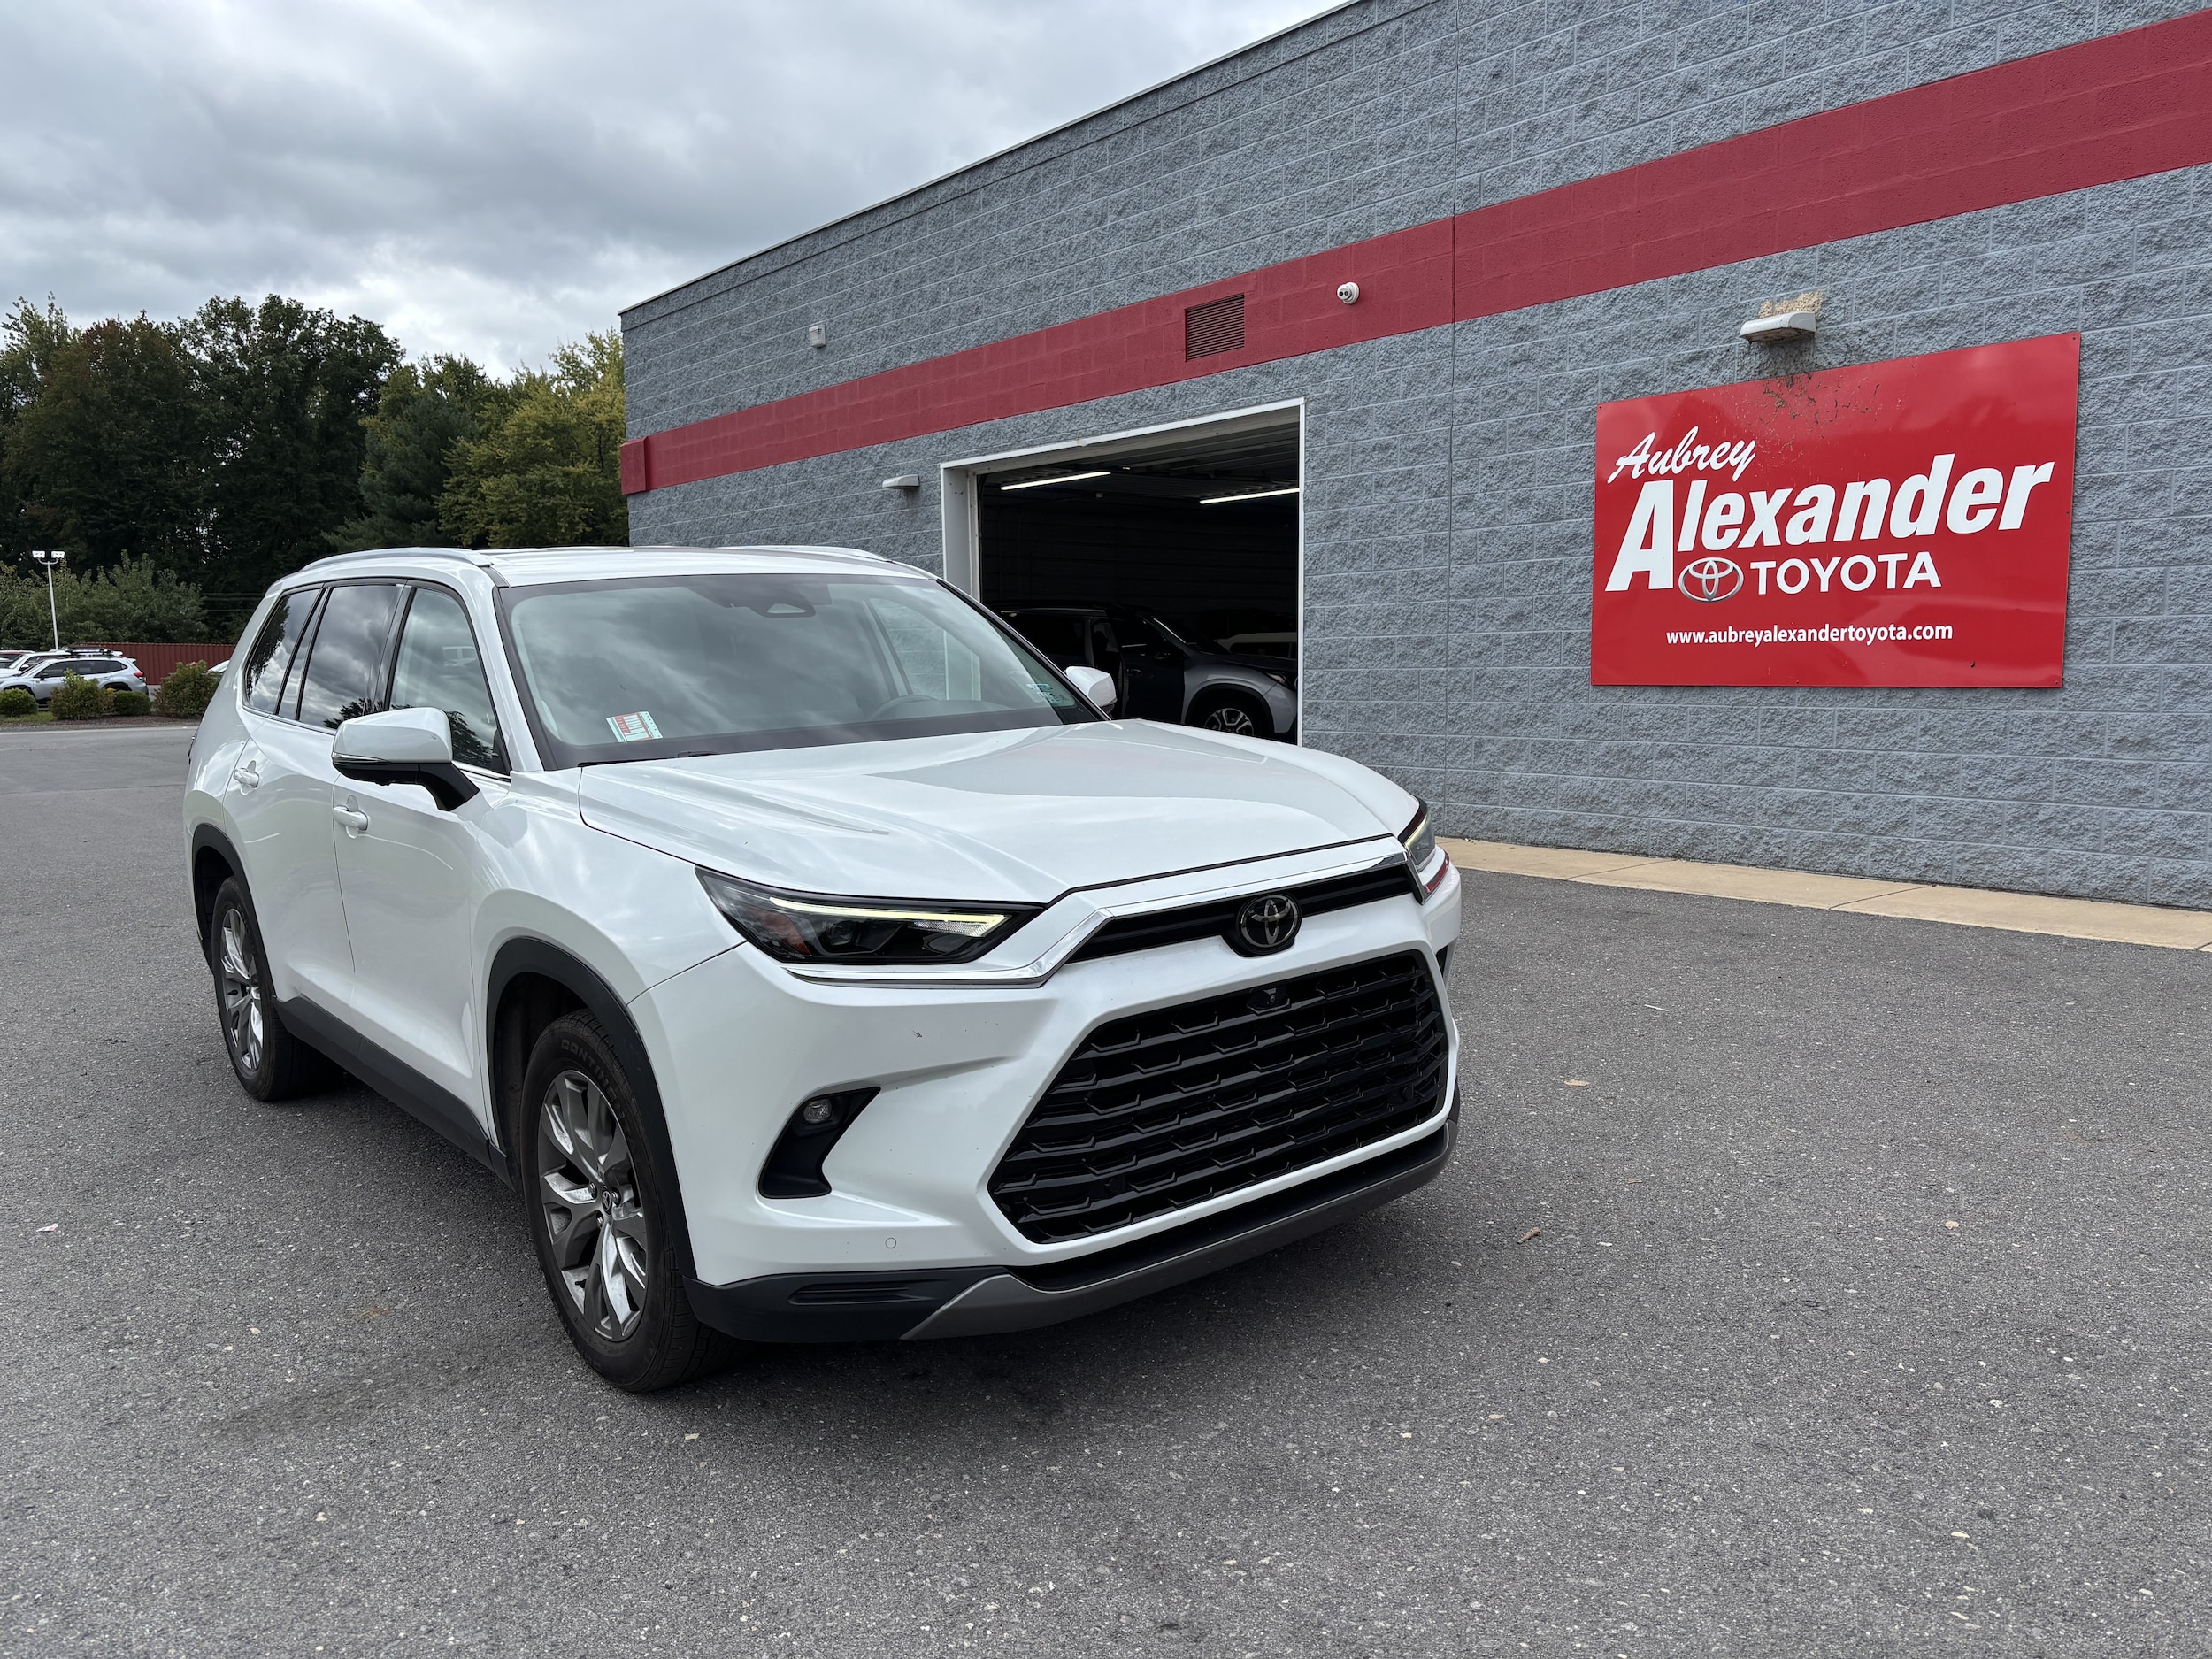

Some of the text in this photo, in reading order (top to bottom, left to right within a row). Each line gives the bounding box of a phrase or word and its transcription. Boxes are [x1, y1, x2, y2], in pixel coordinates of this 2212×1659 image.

[1607, 426, 1756, 482] Aubrey
[1605, 452, 2055, 592] Alexander
[1750, 551, 1942, 595] TOYOTA
[1666, 624, 1953, 647] www.aubreyalexandertoyota.com
